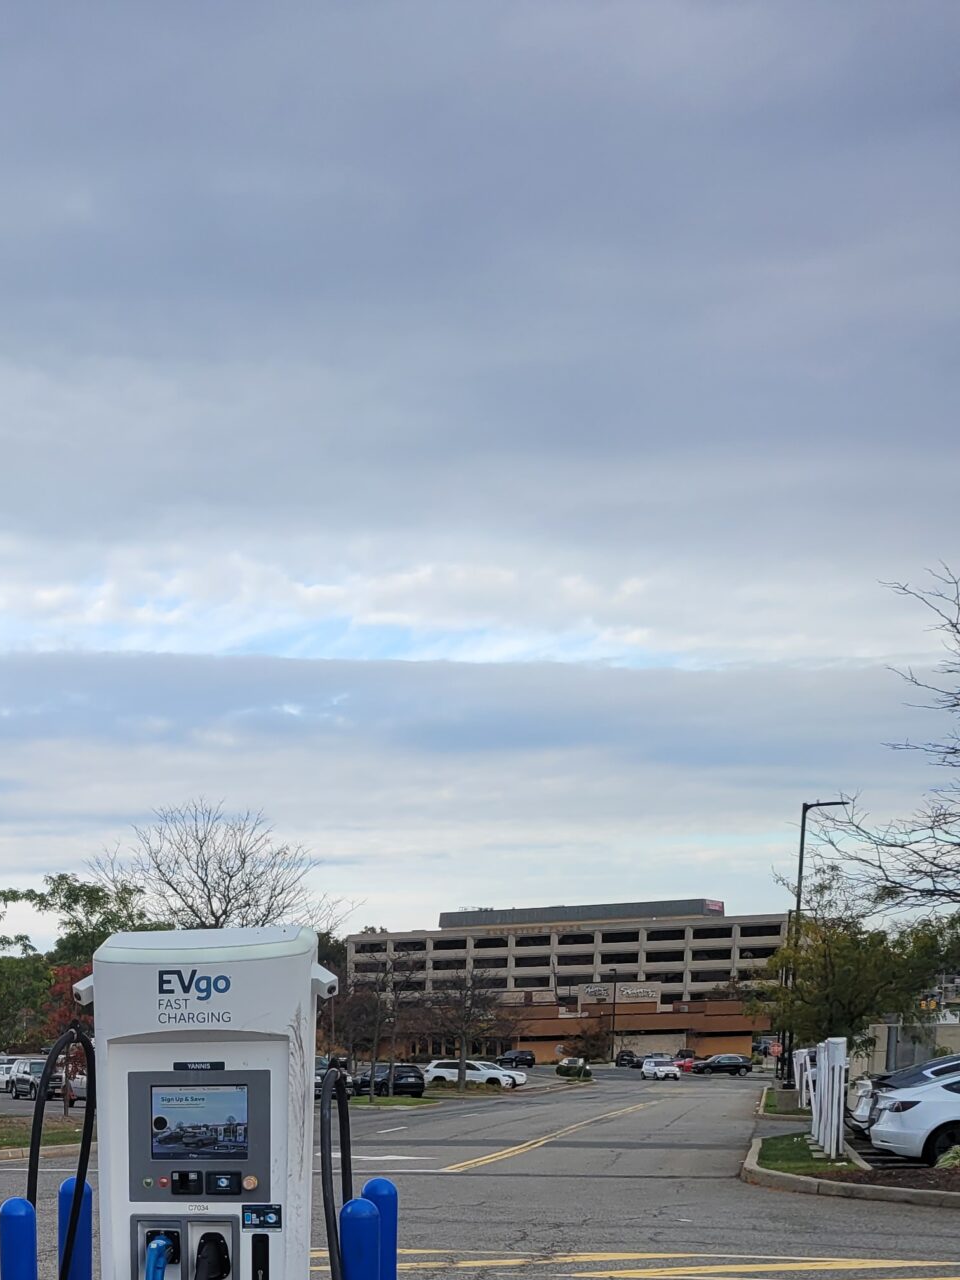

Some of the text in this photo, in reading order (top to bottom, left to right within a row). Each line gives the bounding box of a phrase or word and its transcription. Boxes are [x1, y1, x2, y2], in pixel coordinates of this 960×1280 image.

[158, 969, 231, 1000] EVgo
[158, 999, 190, 1010] FAST
[158, 1012, 232, 1024] CHARGING
